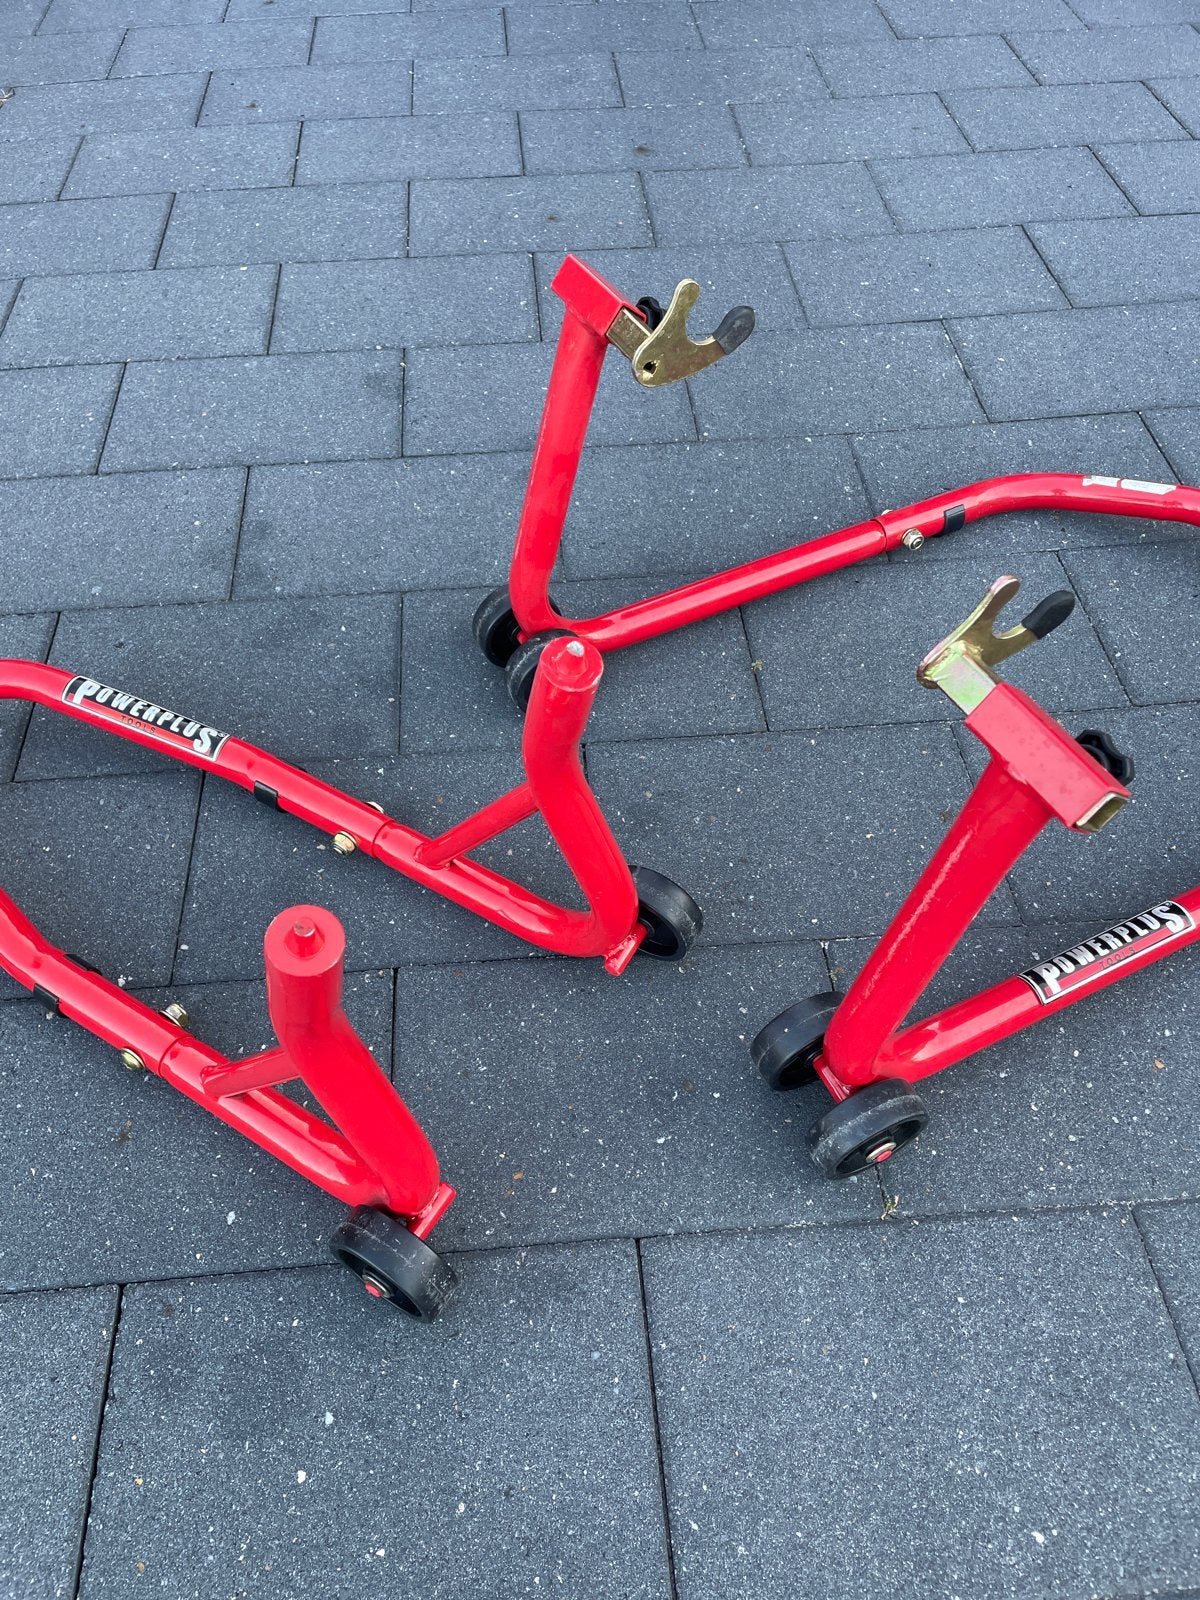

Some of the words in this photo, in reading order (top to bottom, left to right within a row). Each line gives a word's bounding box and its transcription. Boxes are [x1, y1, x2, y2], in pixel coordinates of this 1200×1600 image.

[72, 679, 218, 753] POWERPLUS
[121, 715, 156, 734] TOOLS
[1032, 904, 1184, 995] POWERPLUS
[1099, 946, 1136, 969] TOOLS
